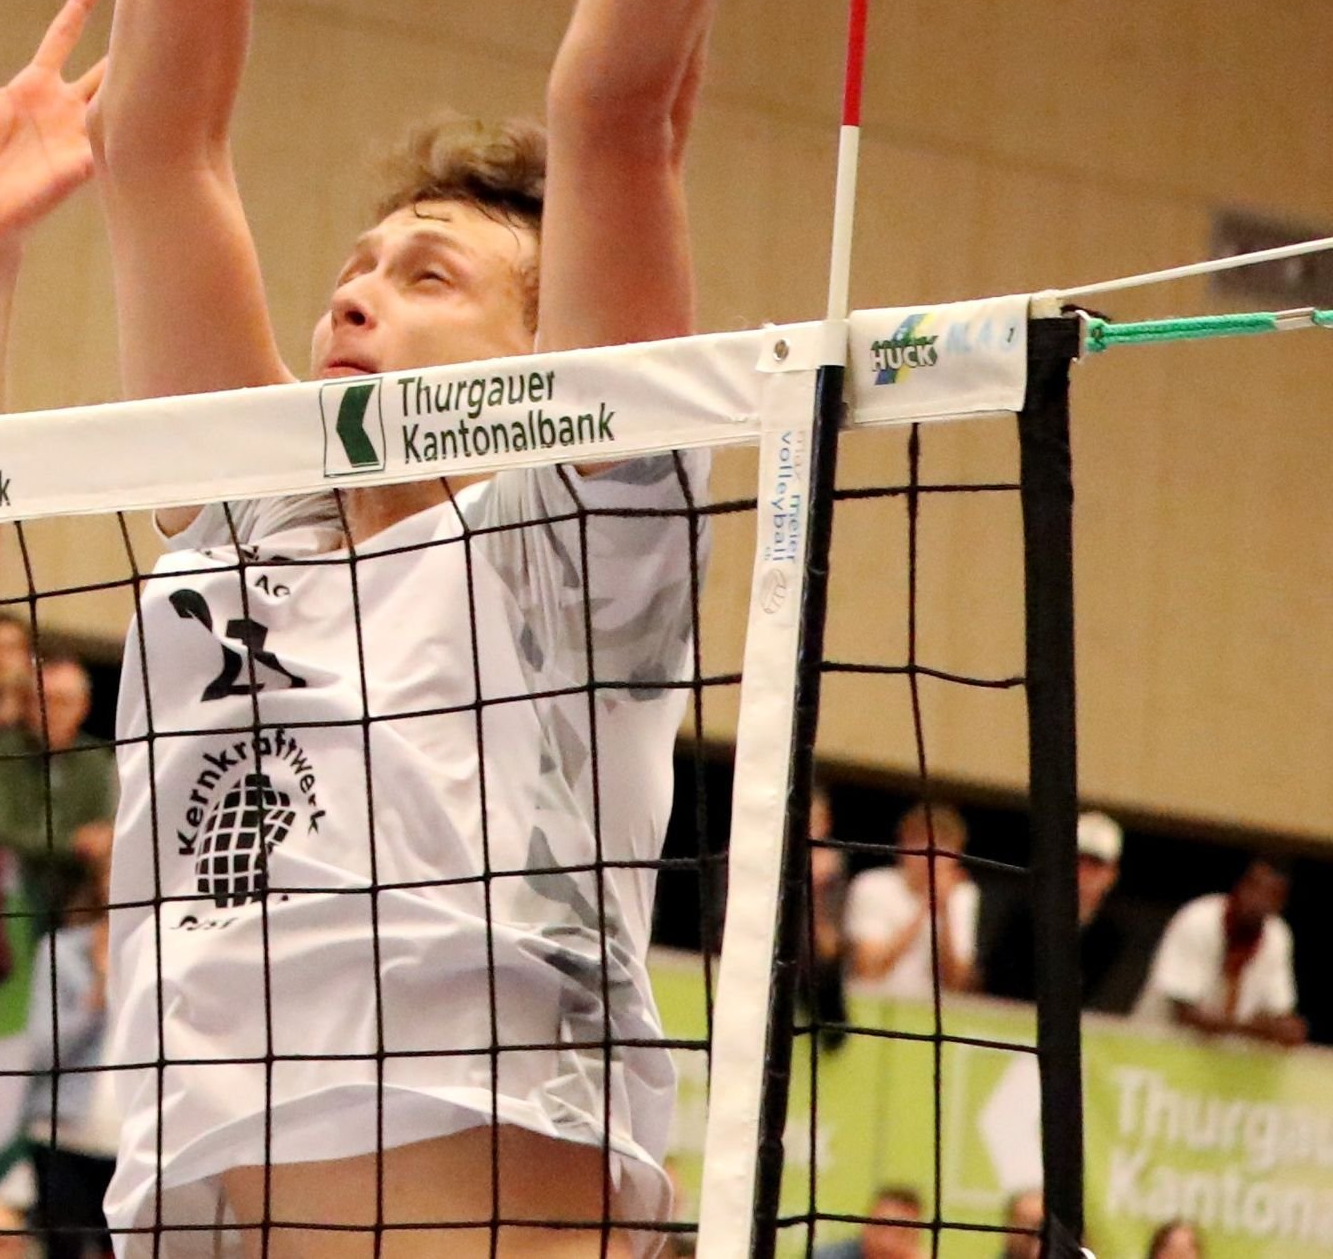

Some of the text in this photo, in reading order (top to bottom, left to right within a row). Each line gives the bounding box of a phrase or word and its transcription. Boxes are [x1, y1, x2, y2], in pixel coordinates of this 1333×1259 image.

[870, 344, 939, 372] HUCK
[398, 370, 556, 420] Thurgauer
[402, 401, 616, 465] Kantonalbank
[770, 430, 793, 562] volleyball
[177, 722, 326, 856] Kernkraftwerk
